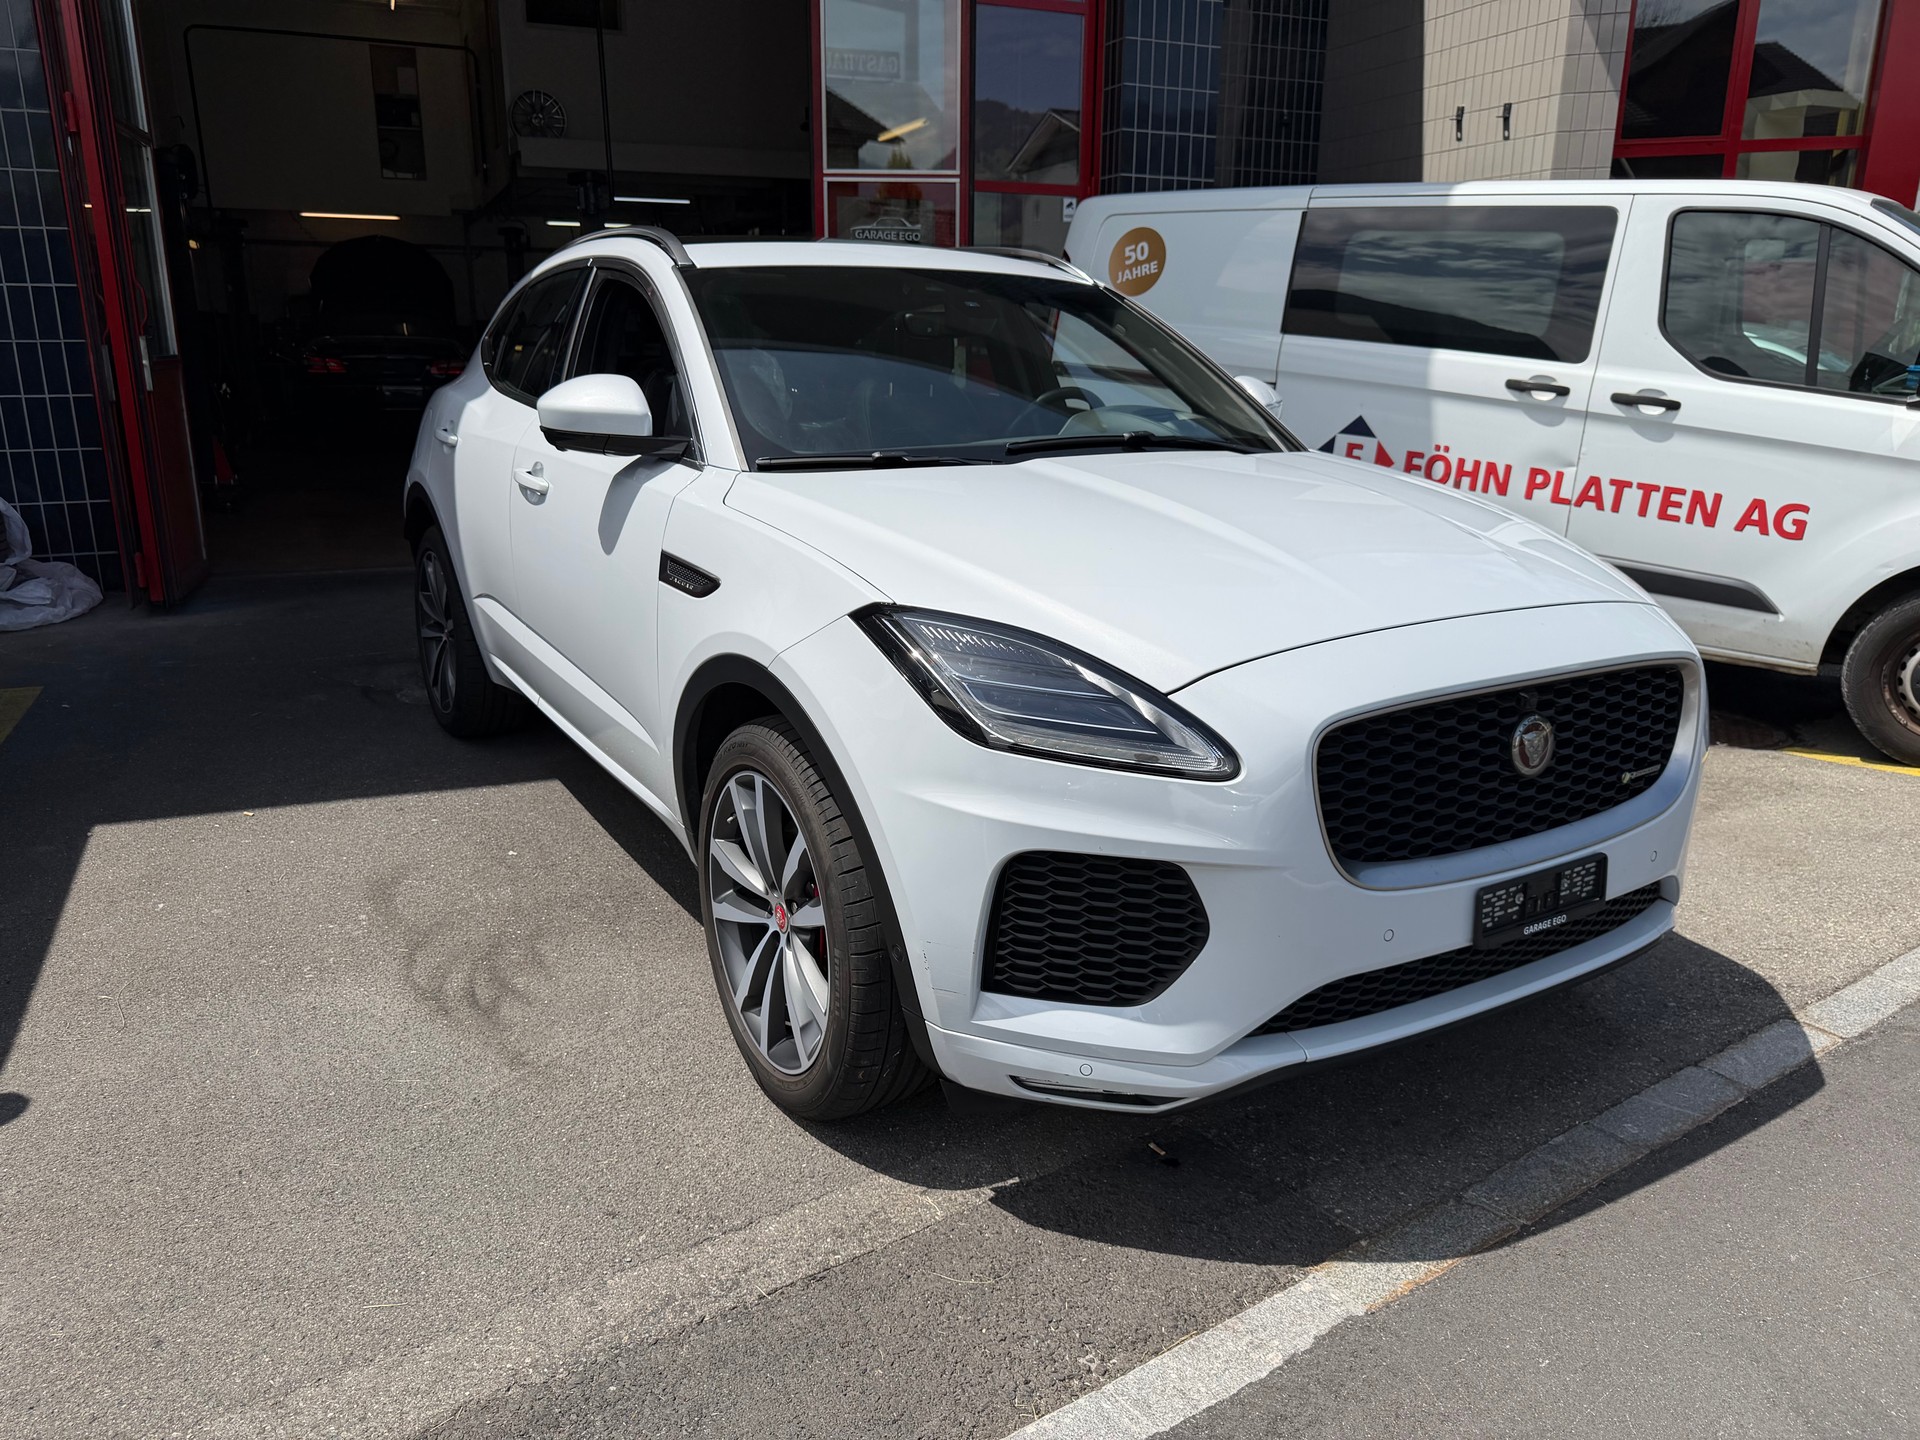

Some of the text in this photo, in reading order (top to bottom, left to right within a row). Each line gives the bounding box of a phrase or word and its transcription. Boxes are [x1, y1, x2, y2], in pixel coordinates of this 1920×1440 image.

[855, 229, 921, 242] GARAGE EGO
[1124, 241, 1149, 265] 50
[1117, 261, 1158, 284] JAHRE
[1403, 444, 1810, 541] FÖHN PLATTEN AG
[1523, 914, 1567, 935] GARAGE EGO
